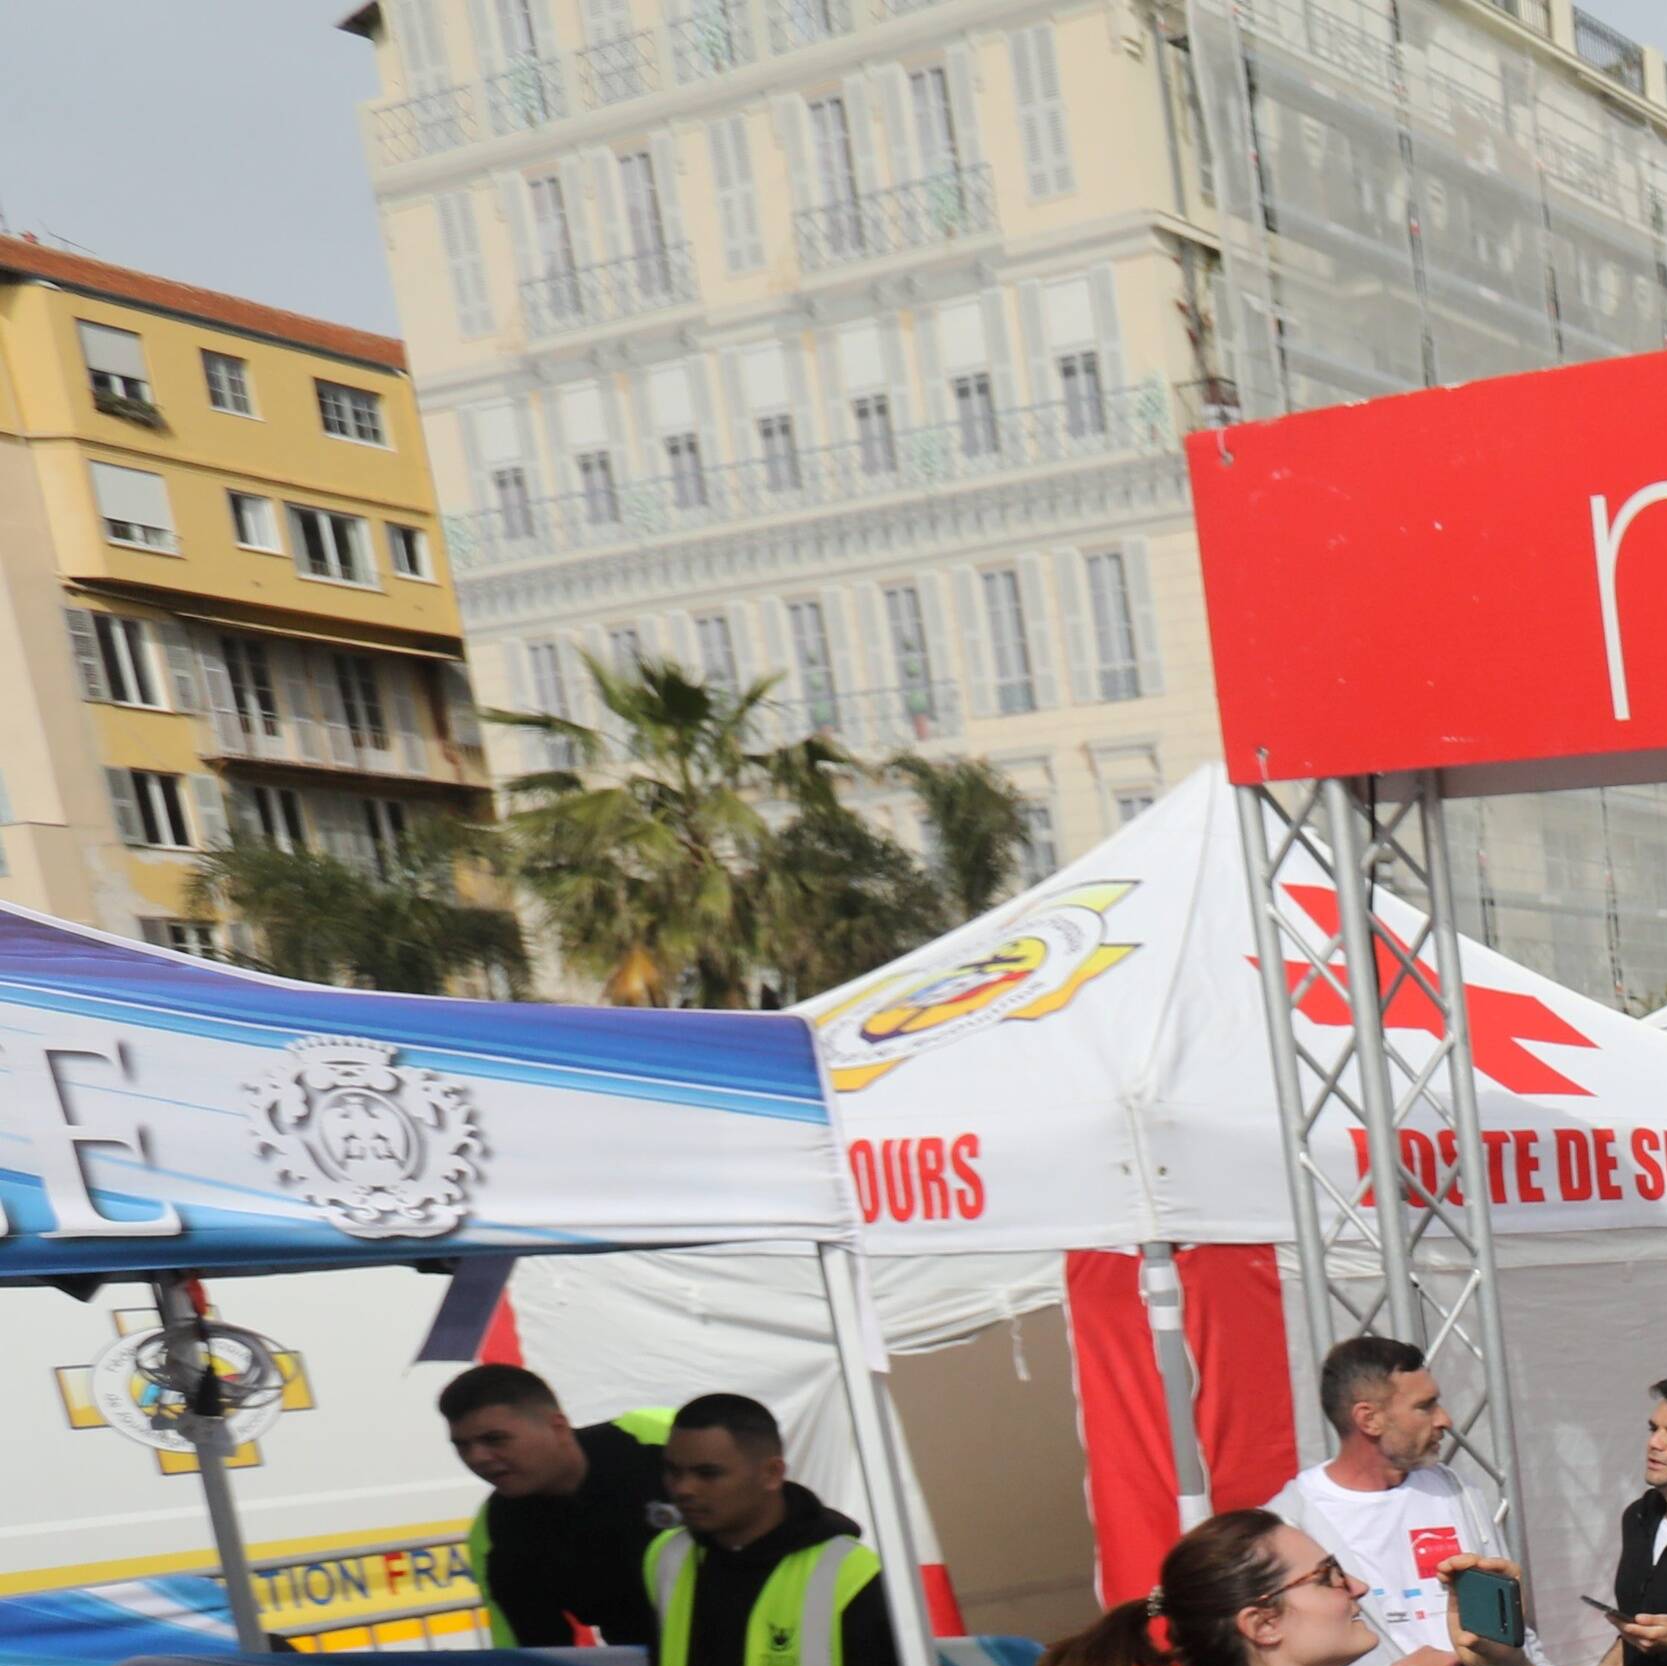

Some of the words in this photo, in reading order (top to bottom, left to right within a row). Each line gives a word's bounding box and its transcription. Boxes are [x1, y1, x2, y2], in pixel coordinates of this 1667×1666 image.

[0, 1042, 183, 1240] E
[1554, 1127, 1623, 1202] DE
[256, 1557, 369, 1613] TION
